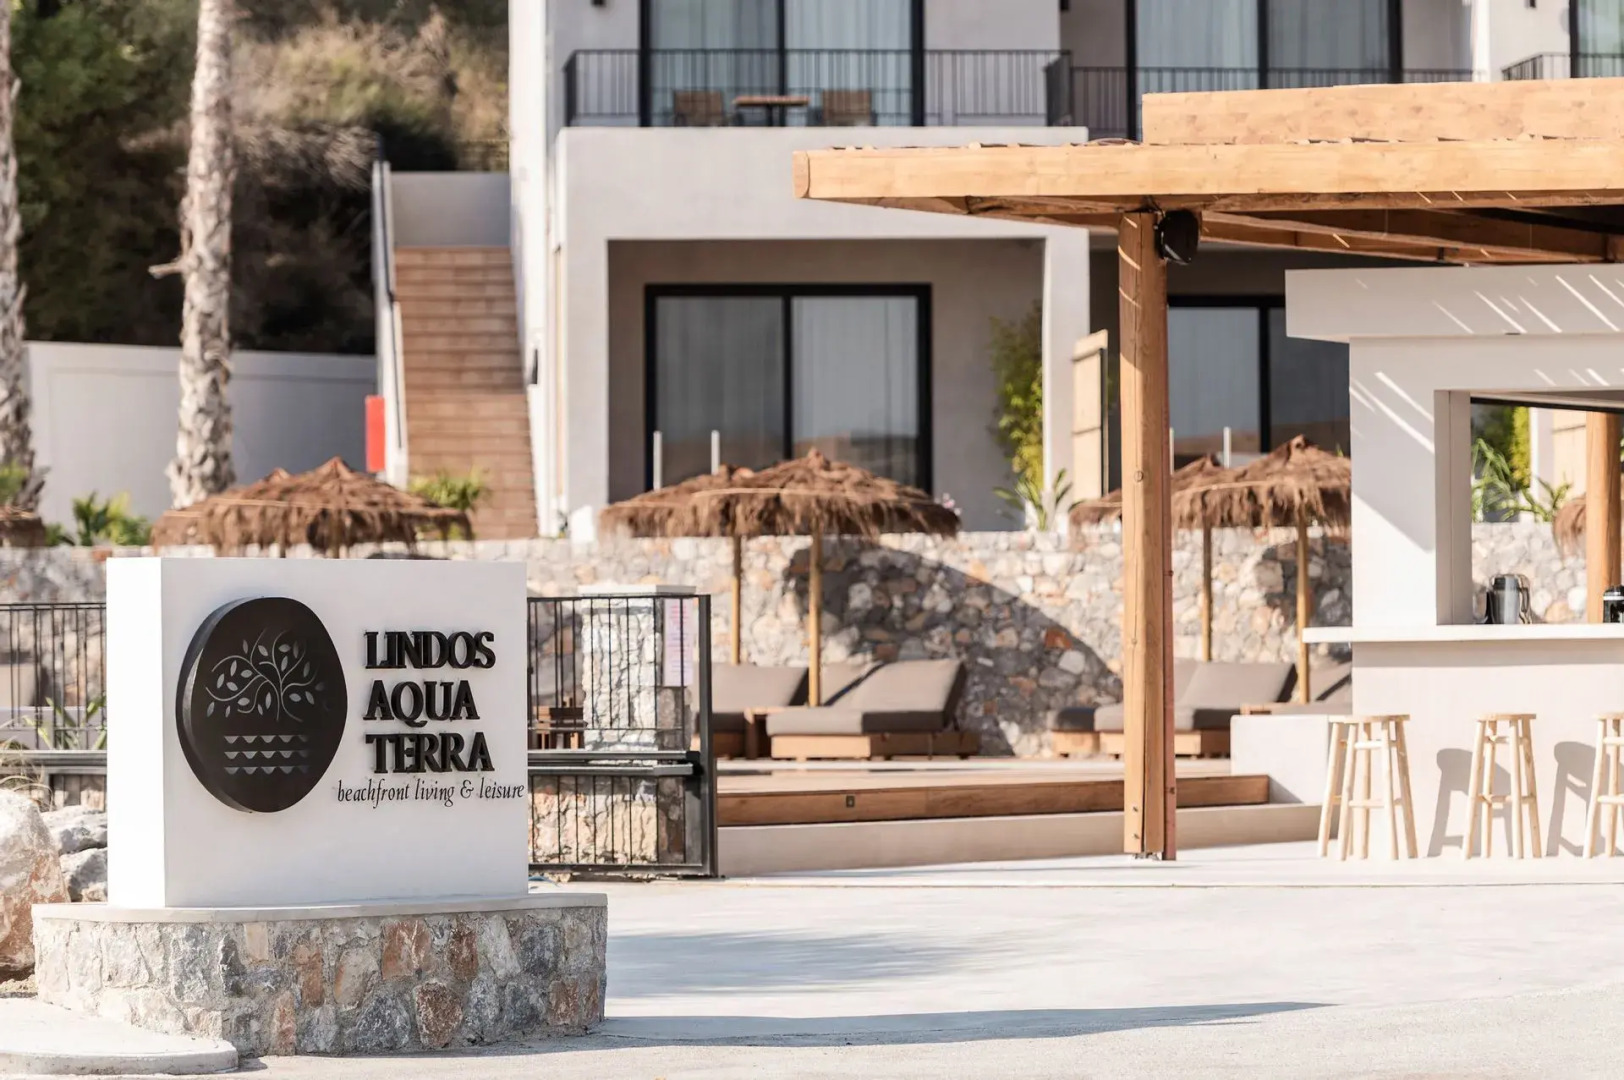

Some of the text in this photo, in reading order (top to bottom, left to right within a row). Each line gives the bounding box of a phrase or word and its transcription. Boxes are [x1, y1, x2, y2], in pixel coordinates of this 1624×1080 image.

[364, 631, 496, 669] LINDOS
[363, 680, 480, 727] AQUA
[365, 732, 495, 773] TERRA
[337, 777, 525, 809] beachfront living & leisure
